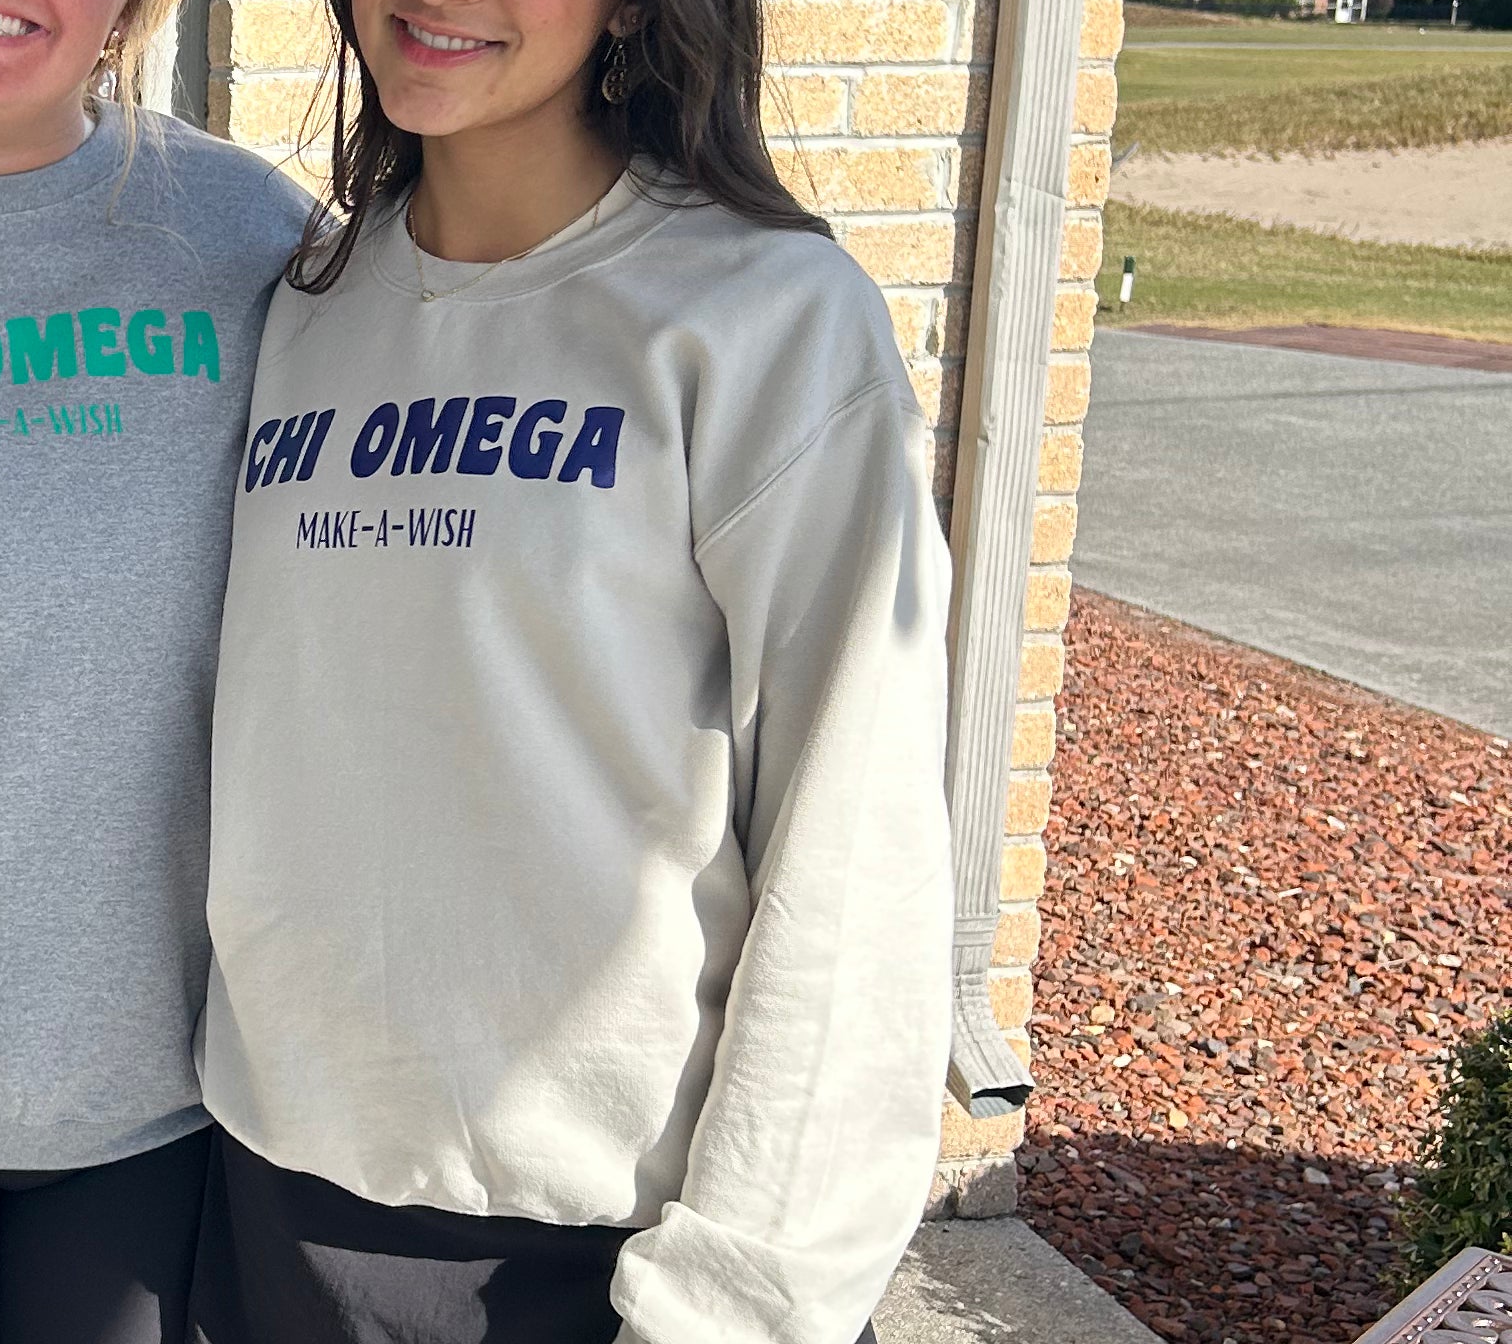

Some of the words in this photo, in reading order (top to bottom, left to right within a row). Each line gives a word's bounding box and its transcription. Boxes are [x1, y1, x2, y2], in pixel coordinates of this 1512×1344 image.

[244, 408, 336, 494] CHI
[350, 395, 625, 489] OMEGA
[296, 508, 477, 550] MAKE-A-WISH
